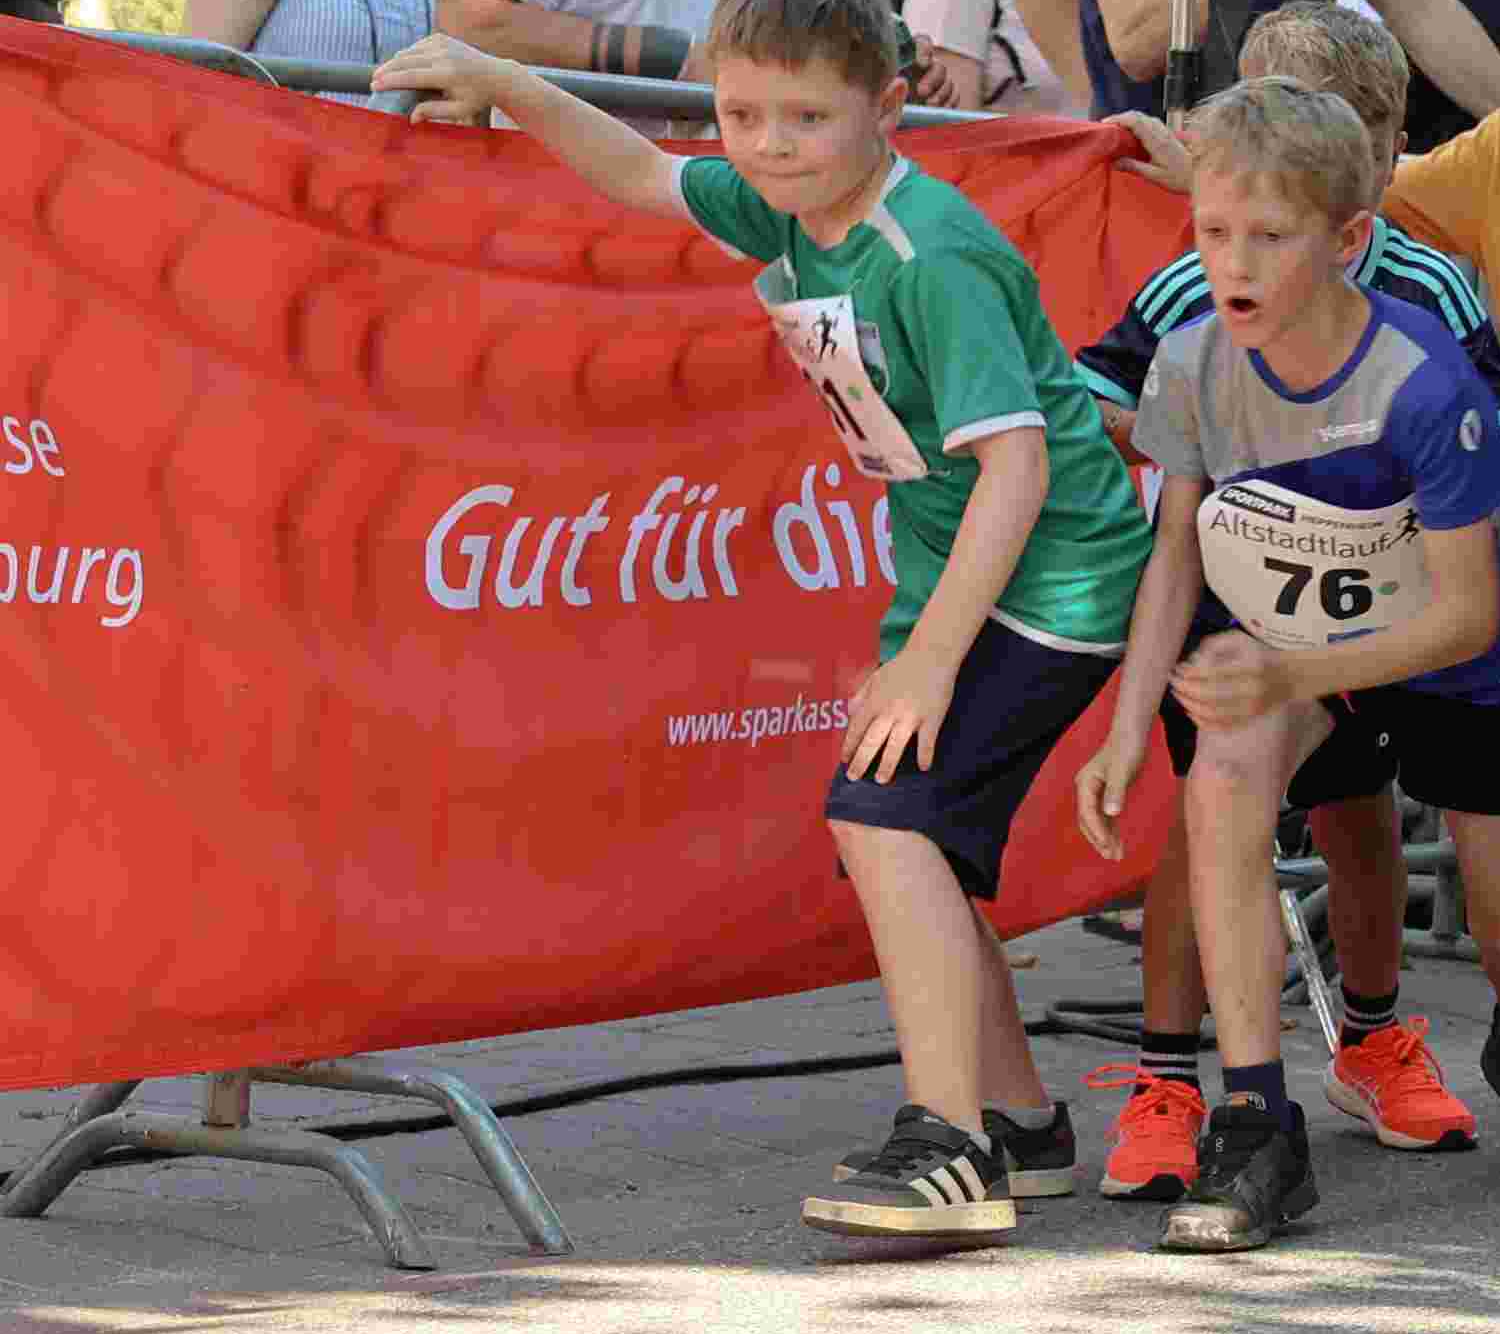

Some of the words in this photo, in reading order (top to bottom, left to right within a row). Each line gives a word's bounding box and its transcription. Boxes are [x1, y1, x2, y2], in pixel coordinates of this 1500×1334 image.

[1, 414, 66, 477] se
[424, 484, 611, 611] Gut
[617, 475, 747, 604] für
[1208, 508, 1393, 559] Altstadtlauf
[1263, 556, 1374, 621] 76
[666, 692, 850, 749] www.sparkass
